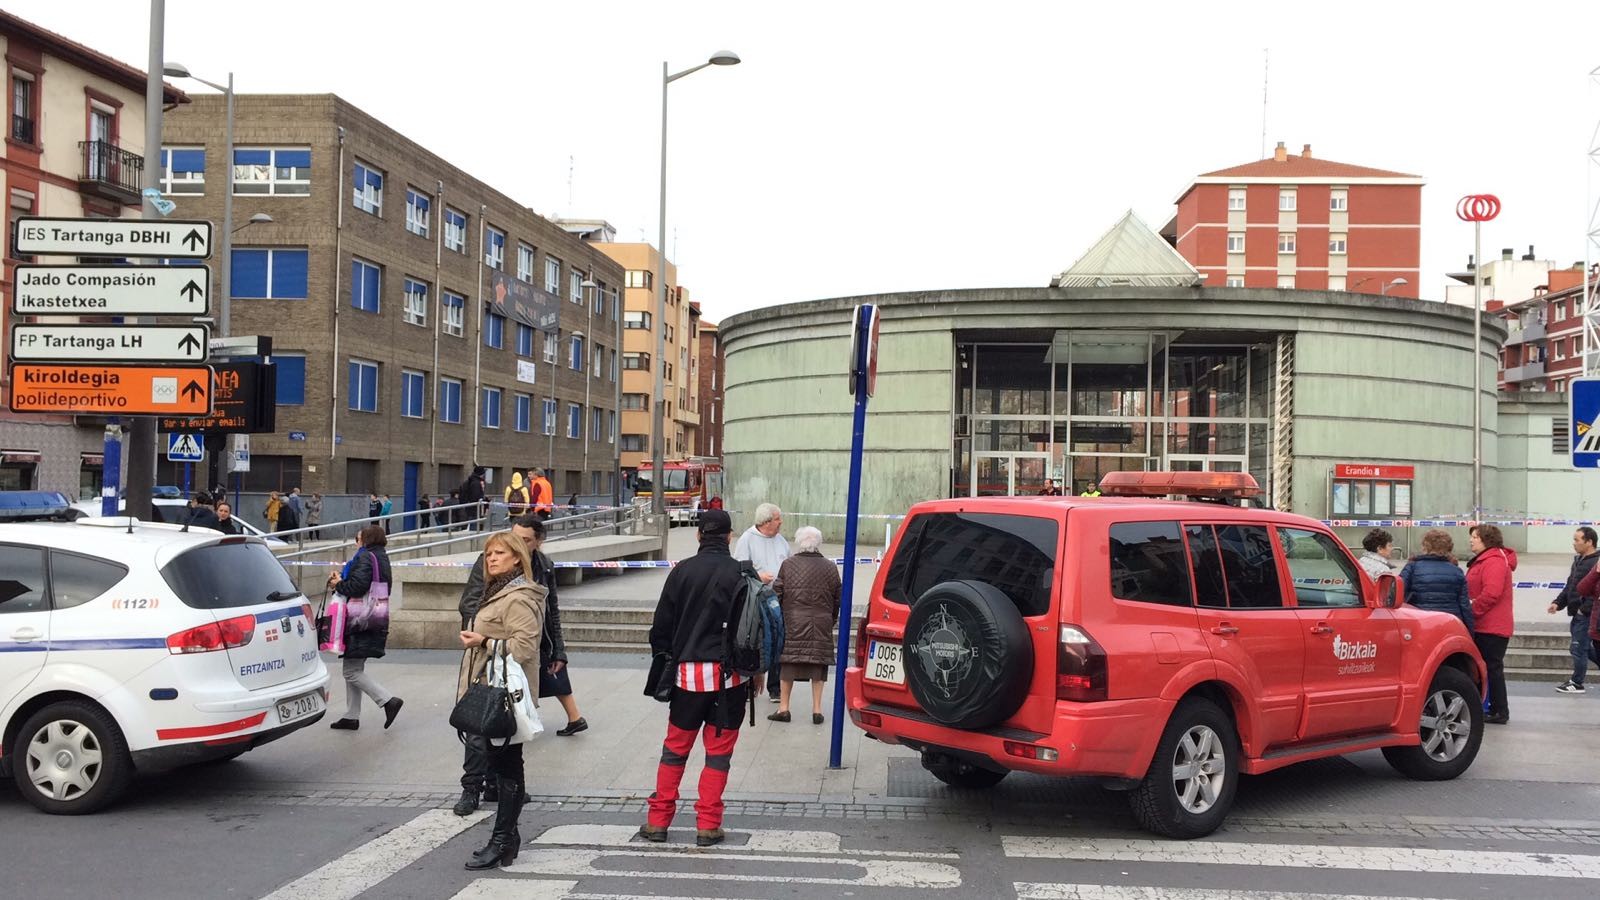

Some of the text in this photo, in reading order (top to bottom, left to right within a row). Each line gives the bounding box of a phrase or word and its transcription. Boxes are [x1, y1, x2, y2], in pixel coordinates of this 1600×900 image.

[22, 227, 171, 246] IES Tartanga DBHI
[22, 272, 156, 289] Jado Compasión
[21, 294, 107, 308] ikastetxea
[19, 334, 143, 351] FP Tartanga LH
[24, 369, 120, 388] kiroldegia
[214, 370, 239, 389] NEA
[16, 391, 127, 409] polideportivo
[1345, 465, 1373, 476] Erandio
[123, 599, 148, 609] 112
[1340, 640, 1377, 660] Bizkaia
[240, 659, 286, 676] ERTZAINTZA
[875, 663, 895, 680] DSR
